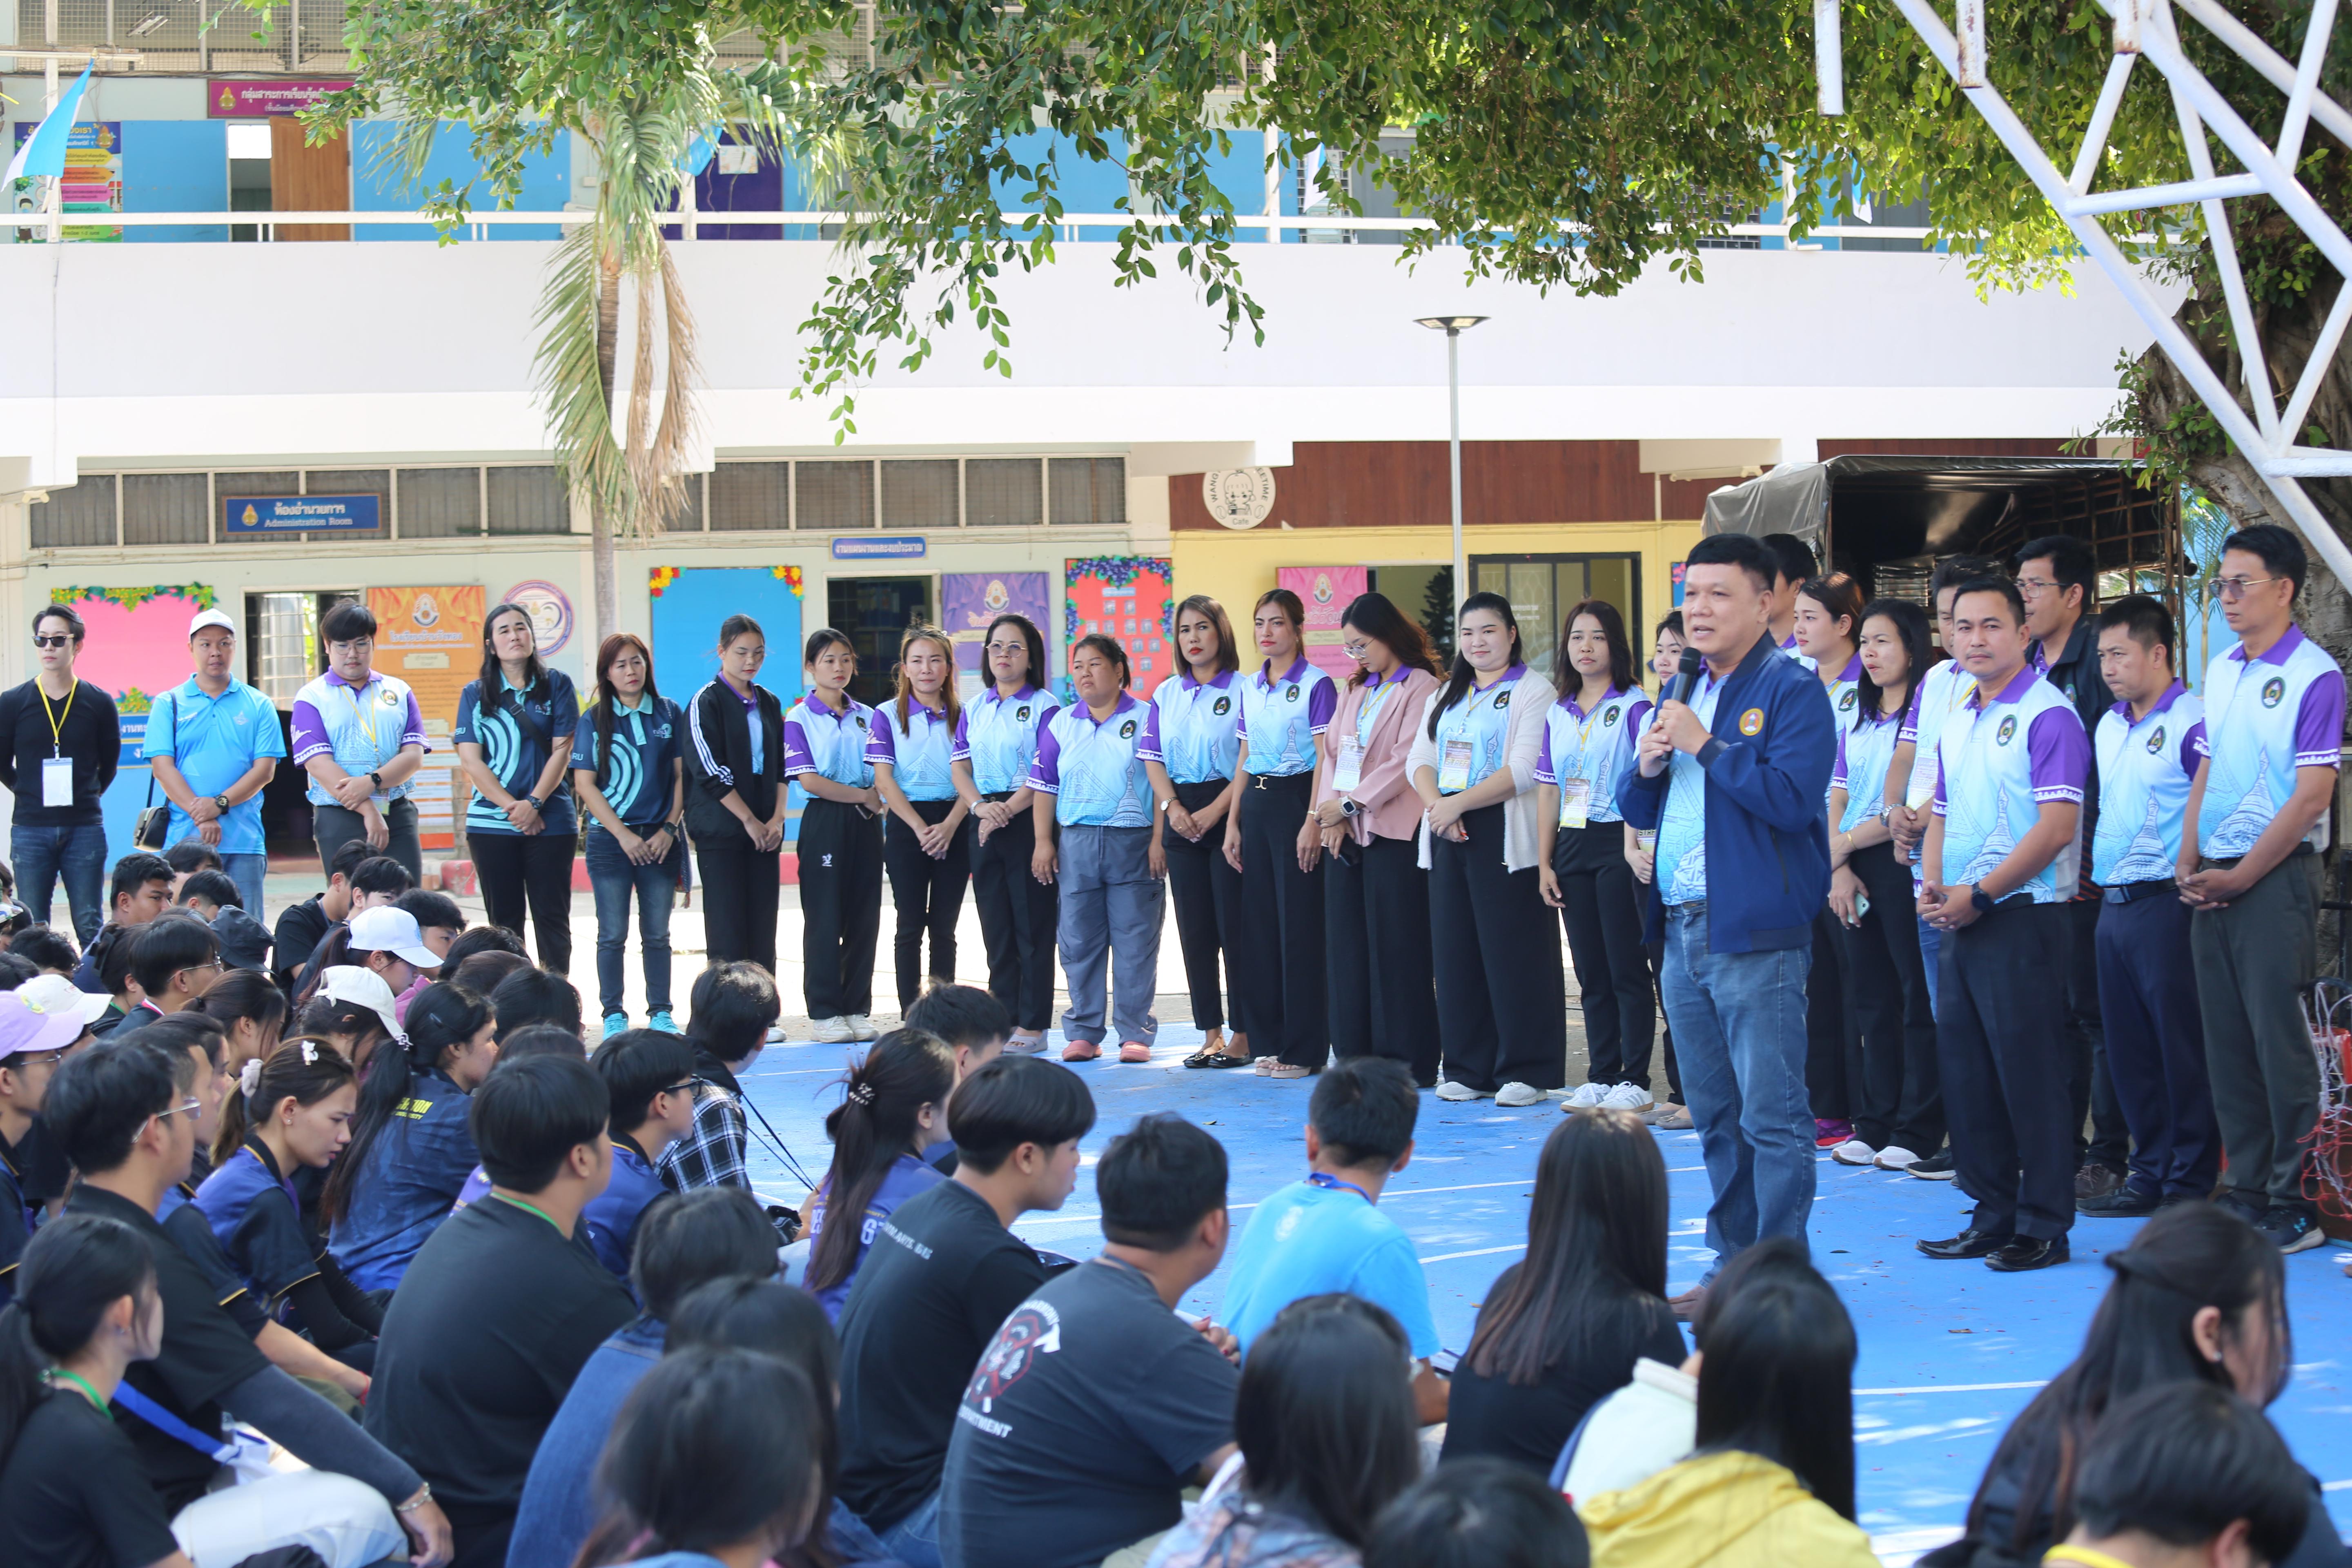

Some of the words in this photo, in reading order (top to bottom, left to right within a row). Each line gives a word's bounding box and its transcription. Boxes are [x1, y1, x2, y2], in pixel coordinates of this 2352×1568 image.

[1255, 467, 1269, 502] EETIME
[274, 501, 345, 515] ห้องอำนวยการ
[265, 519, 326, 527] Administration
[328, 517, 353, 526] Room
